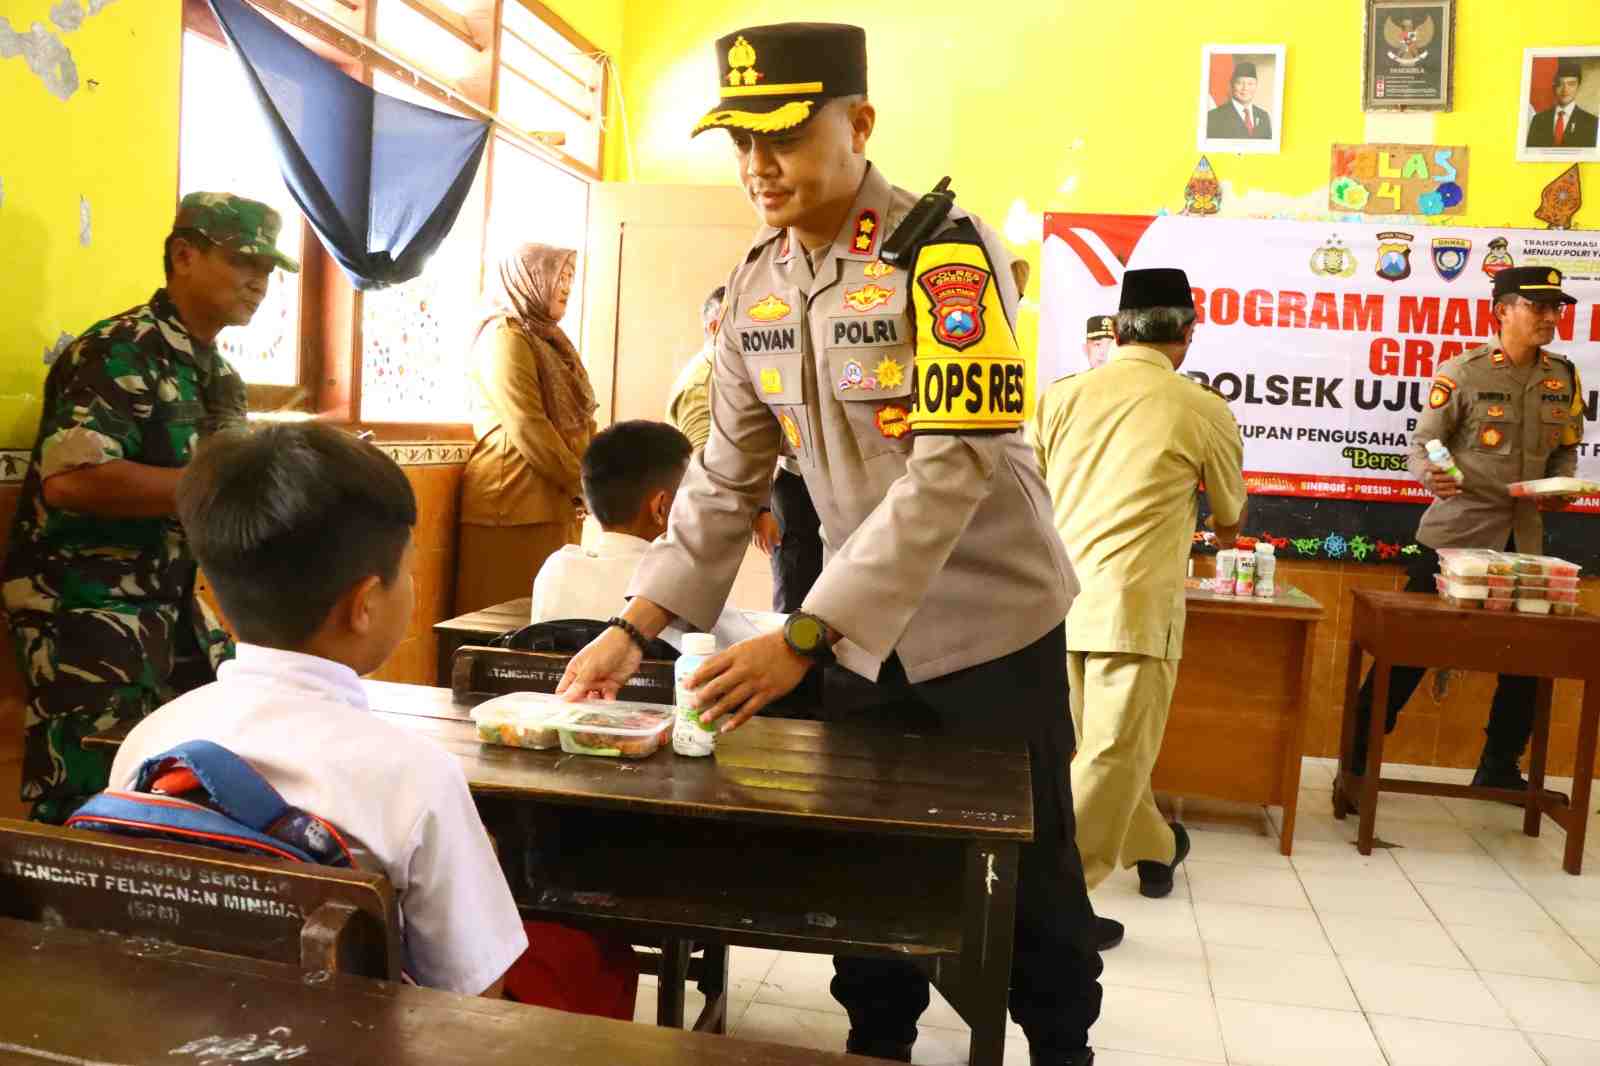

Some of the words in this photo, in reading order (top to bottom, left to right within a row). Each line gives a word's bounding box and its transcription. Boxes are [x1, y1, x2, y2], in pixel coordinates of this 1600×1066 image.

[1334, 148, 1457, 182] KELAS
[1376, 181, 1401, 211] 4
[1523, 239, 1598, 248] TRANSFORMASI
[1523, 248, 1562, 257] MENUJU
[1563, 249, 1590, 257] POLRI
[1189, 286, 1385, 333] ROGRAM
[1397, 295, 1577, 342] MAKN
[741, 328, 796, 352] ROVAN
[834, 319, 898, 345] POLRI
[924, 362, 984, 414] OPS
[989, 363, 1025, 414] RES
[1239, 424, 1293, 441] UPAN
[1296, 427, 1408, 447] PENGUSAHA
[104, 874, 218, 908] PELAYANAN
